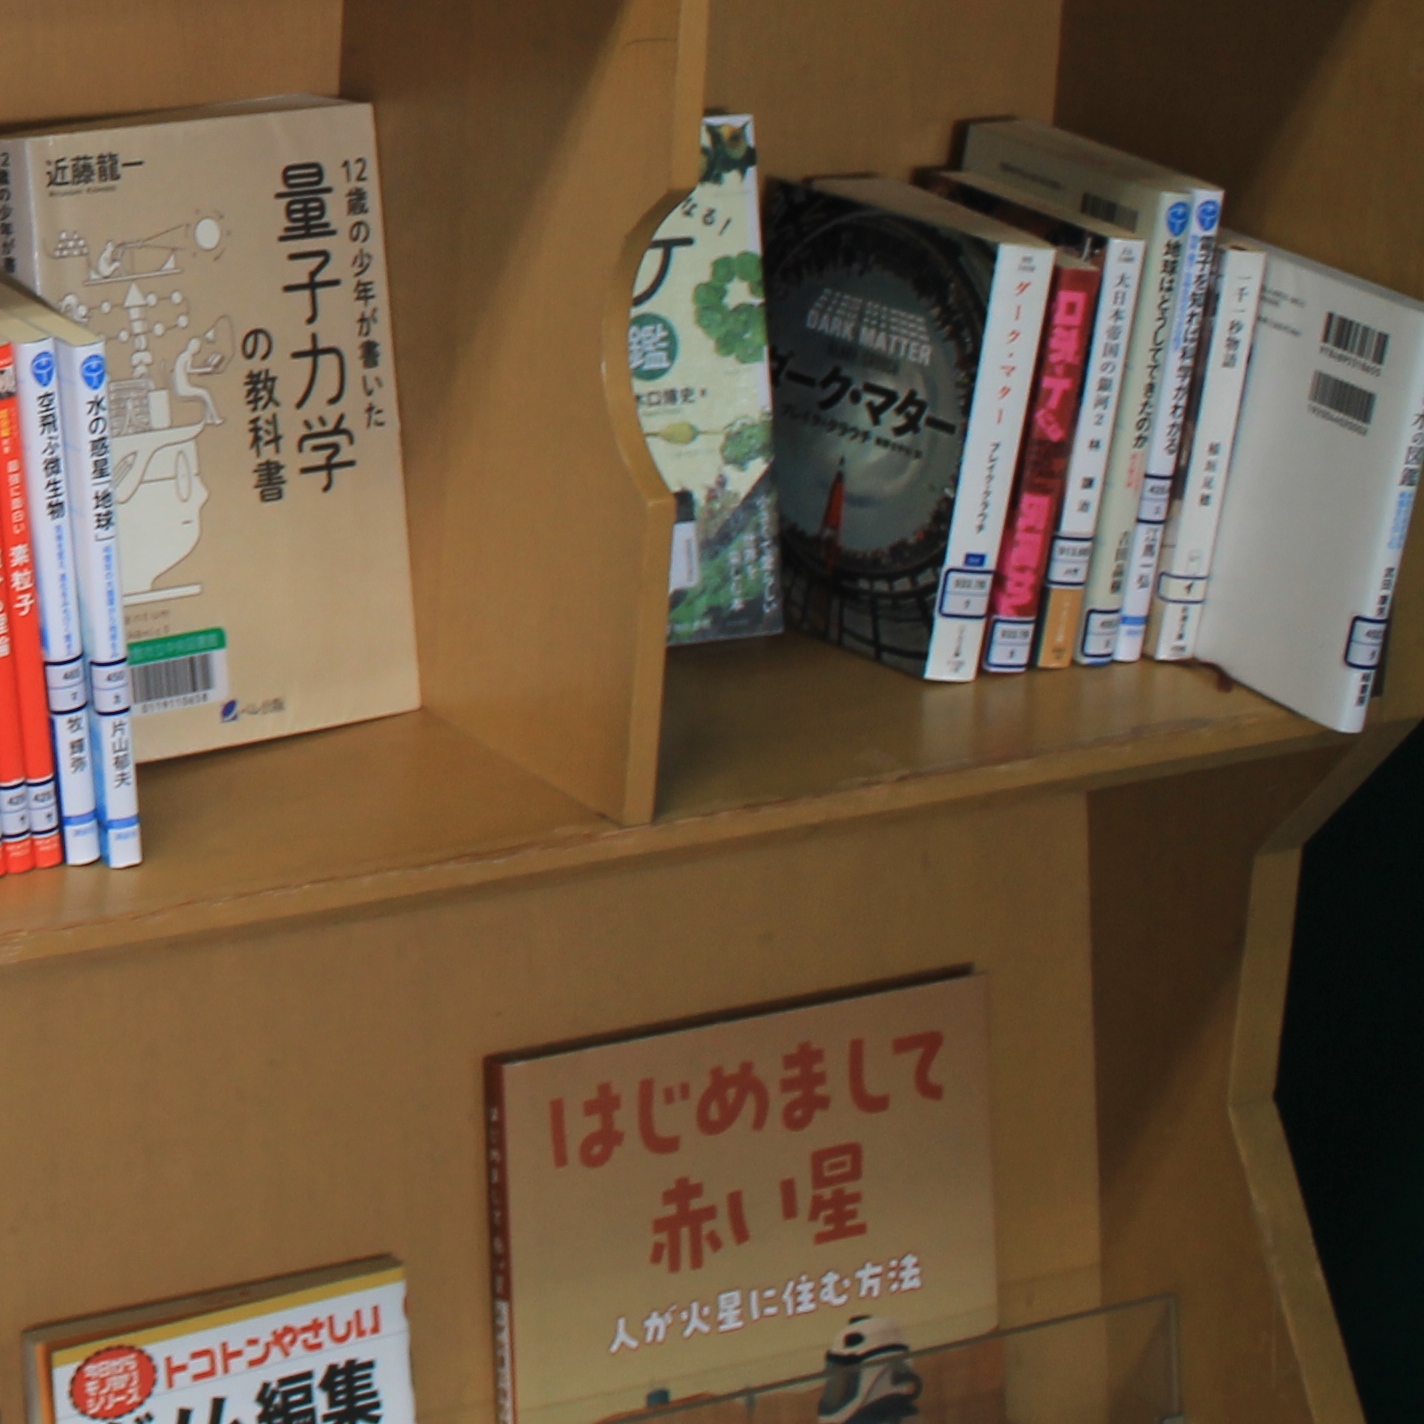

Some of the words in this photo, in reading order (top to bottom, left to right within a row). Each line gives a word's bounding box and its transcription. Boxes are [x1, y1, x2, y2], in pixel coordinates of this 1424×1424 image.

[46, 152, 145, 187] 近藤龍一
[274, 161, 357, 493] 量子力学
[341, 157, 386, 429] 12歳の少年が書いた
[806, 308, 857, 343] DARK
[859, 326, 933, 366] MATTER
[1132, 239, 1181, 450] 地球はどうしてできたのか
[37, 390, 66, 520] 空飛ぶ微生物
[85, 394, 116, 543] 水の惑星「地球」
[242, 327, 288, 504] の教科書
[8, 542, 36, 617] 素粒子
[109, 718, 133, 788] 片山郁夫
[550, 1030, 945, 1169] はじめまして
[650, 1141, 868, 1274] 赤い星
[164, 1304, 382, 1389] トコトンやさしい
[608, 1253, 923, 1354] 人が火星に住む方法
